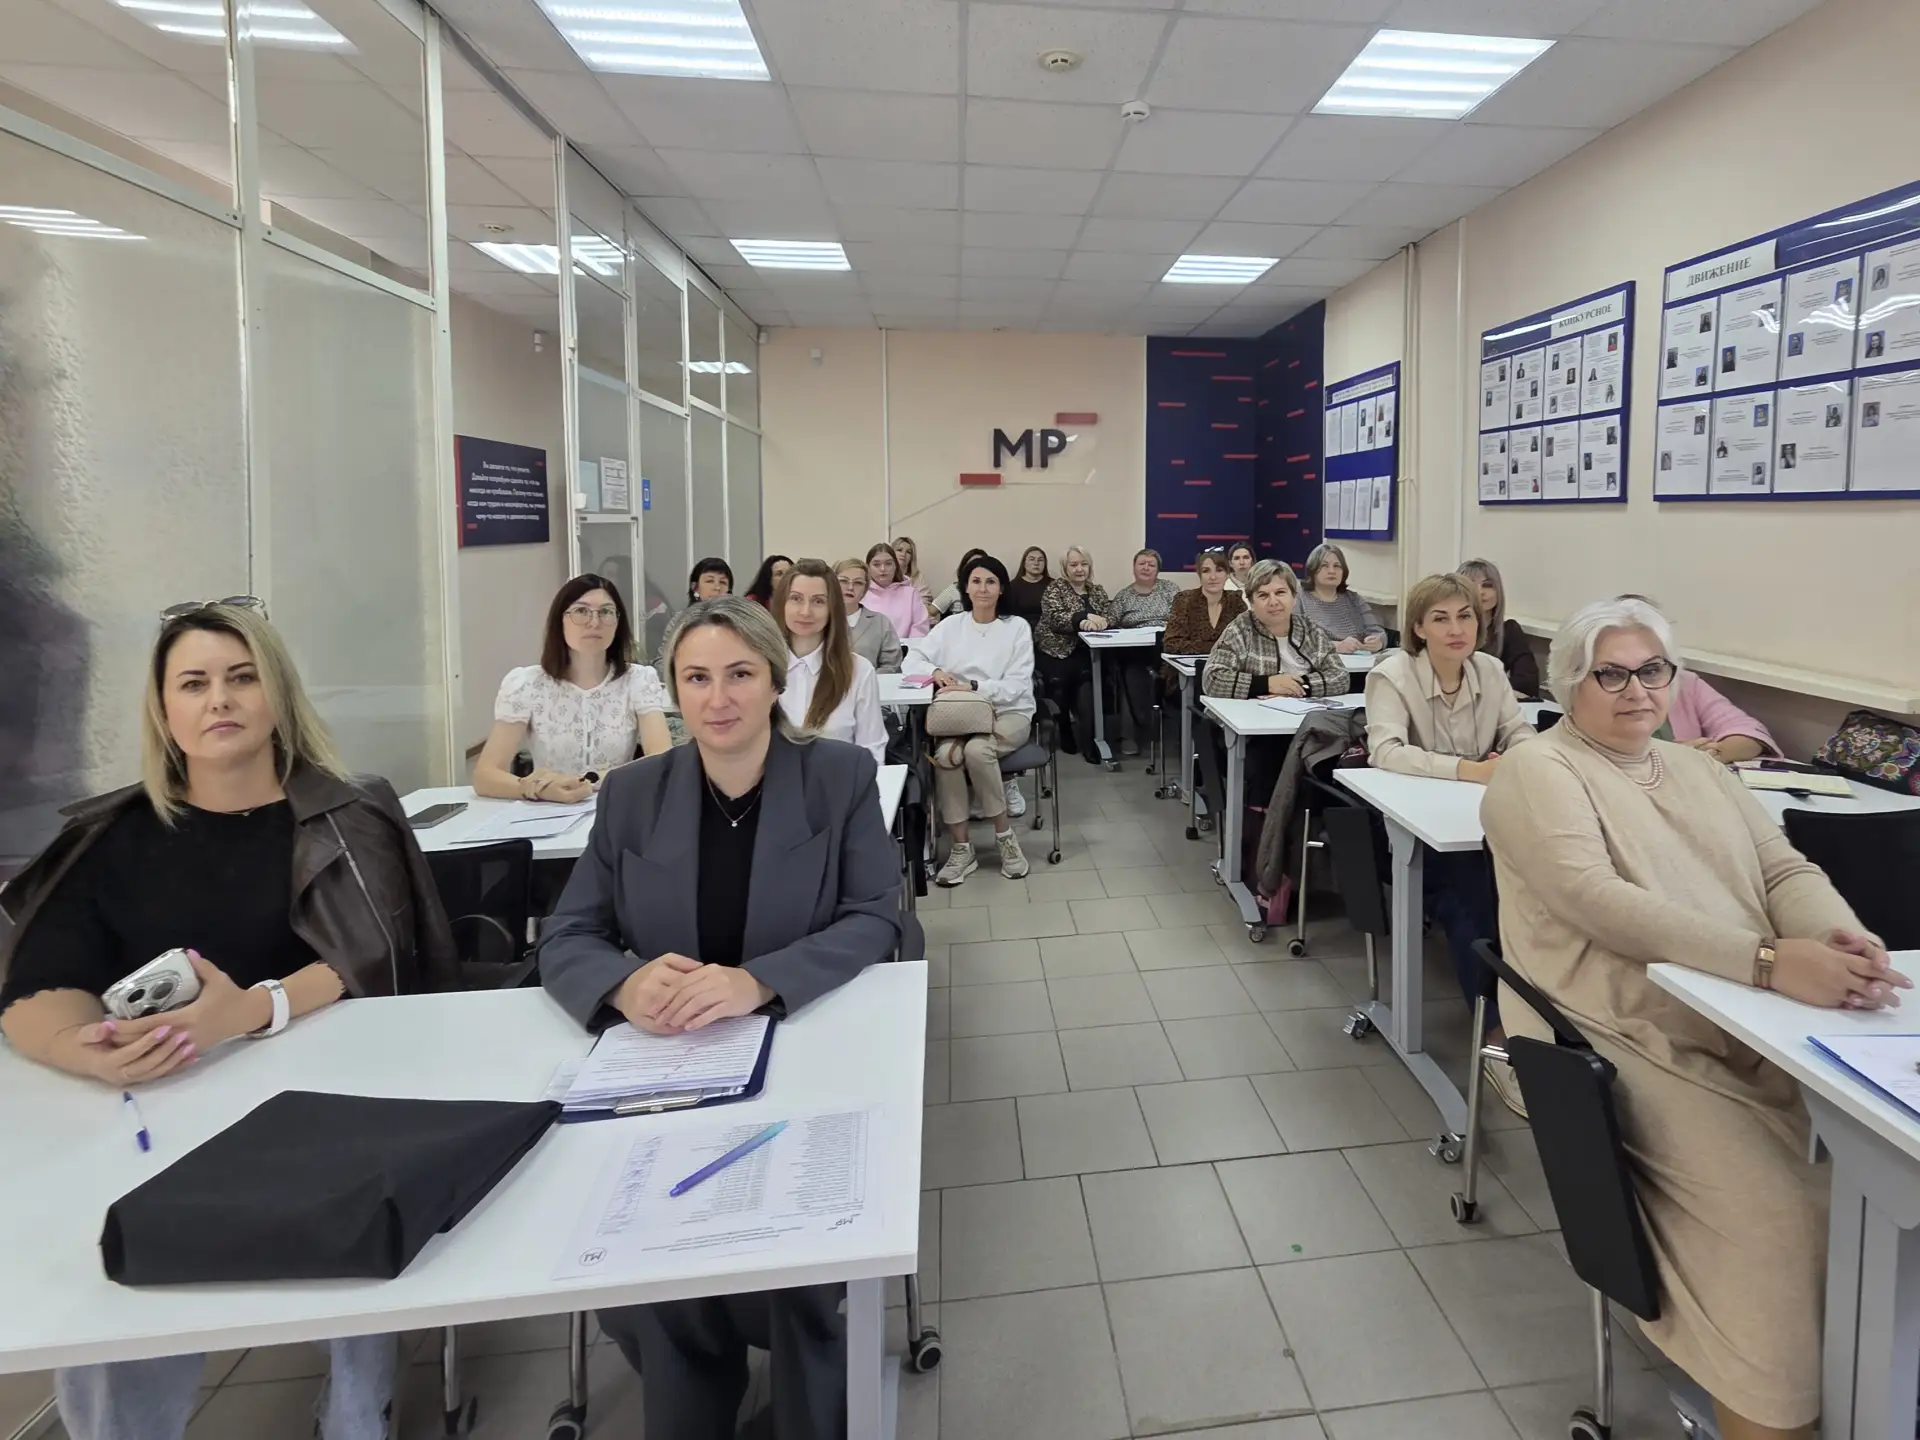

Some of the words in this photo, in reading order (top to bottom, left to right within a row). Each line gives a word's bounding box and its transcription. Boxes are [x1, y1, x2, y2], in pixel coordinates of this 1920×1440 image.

[1687, 257, 1751, 287] ДВИЖЕНИЕ
[1559, 304, 1612, 328] КОНКУРСНОЕ
[994, 429, 1066, 467] МР
